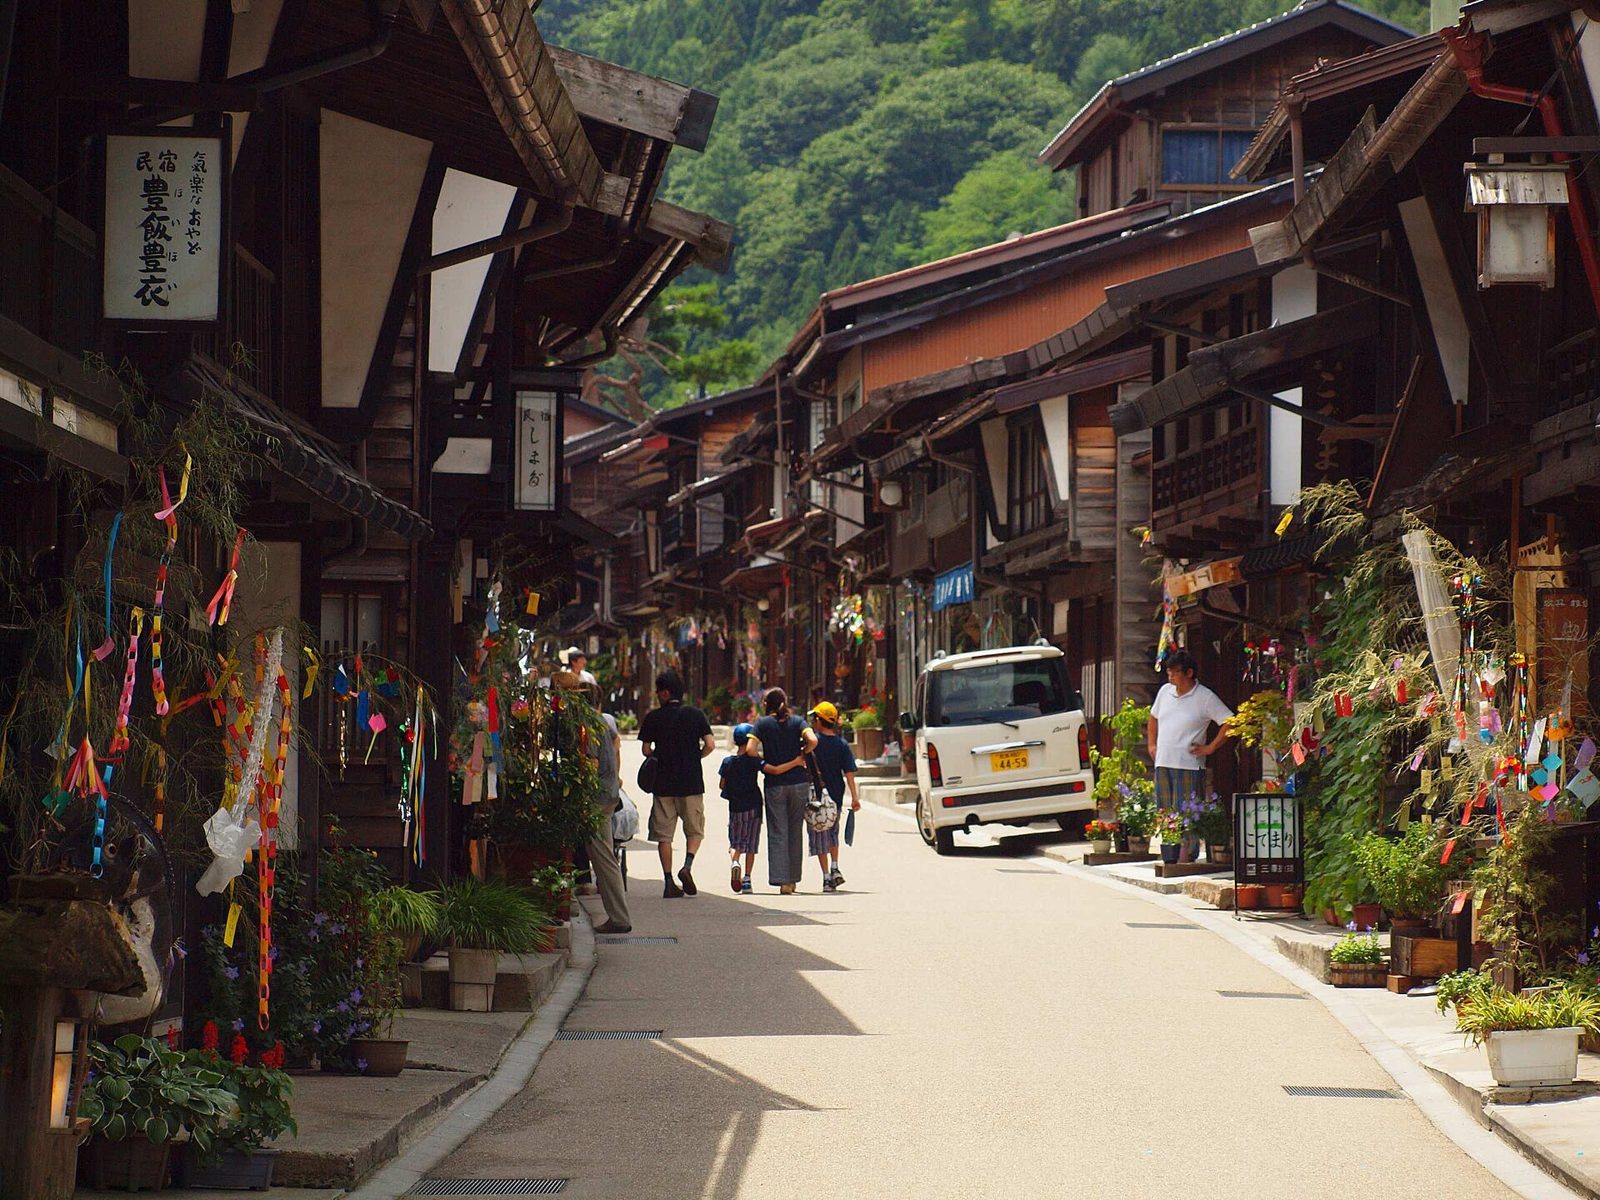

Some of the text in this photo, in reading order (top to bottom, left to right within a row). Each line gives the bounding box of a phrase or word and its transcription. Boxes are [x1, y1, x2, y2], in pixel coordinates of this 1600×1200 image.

[137, 150, 178, 173] 民宿
[134, 174, 173, 307] 豊飯豊衣
[999, 757, 1028, 769] 44-59
